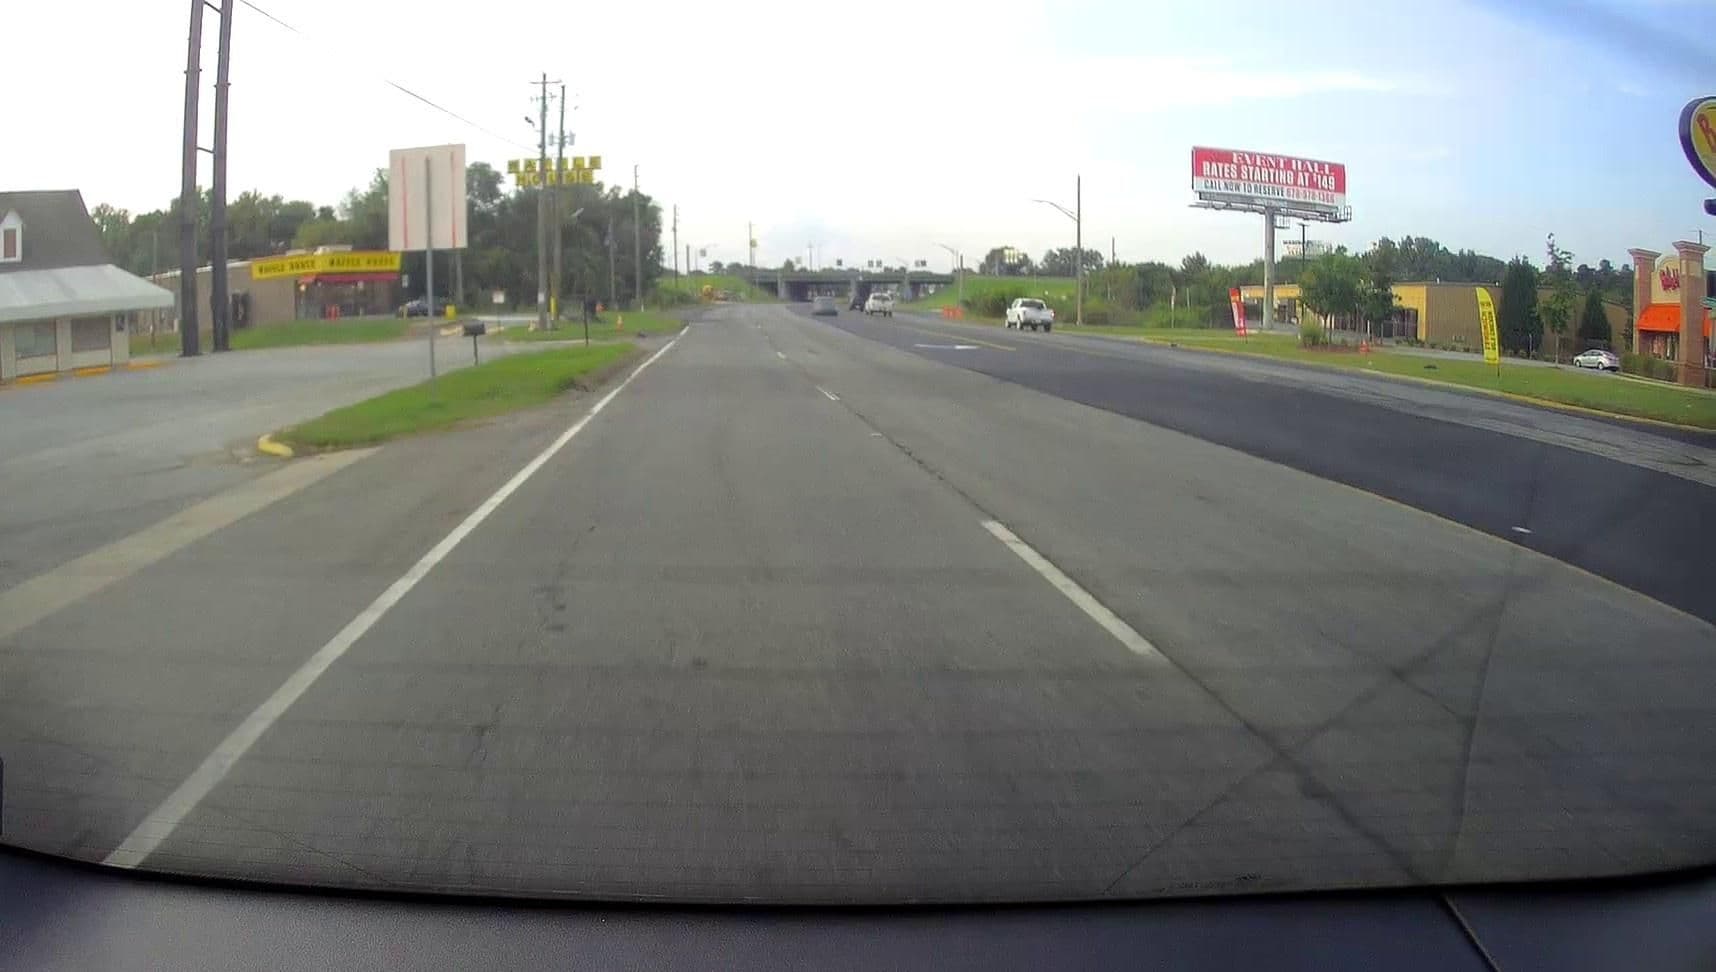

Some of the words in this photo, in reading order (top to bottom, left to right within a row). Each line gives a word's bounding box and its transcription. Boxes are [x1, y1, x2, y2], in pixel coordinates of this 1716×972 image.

[1202, 161, 1238, 179] RATES
[1241, 165, 1294, 185] STARTING
[1297, 171, 1310, 187] AT
[1232, 152, 1288, 169] EVENT
[1292, 159, 1335, 176] HALL
[1204, 179, 1222, 191] CALL
[1223, 181, 1241, 193] NOW
[1242, 182, 1253, 193] TO
[1253, 183, 1285, 198] RESERVE
